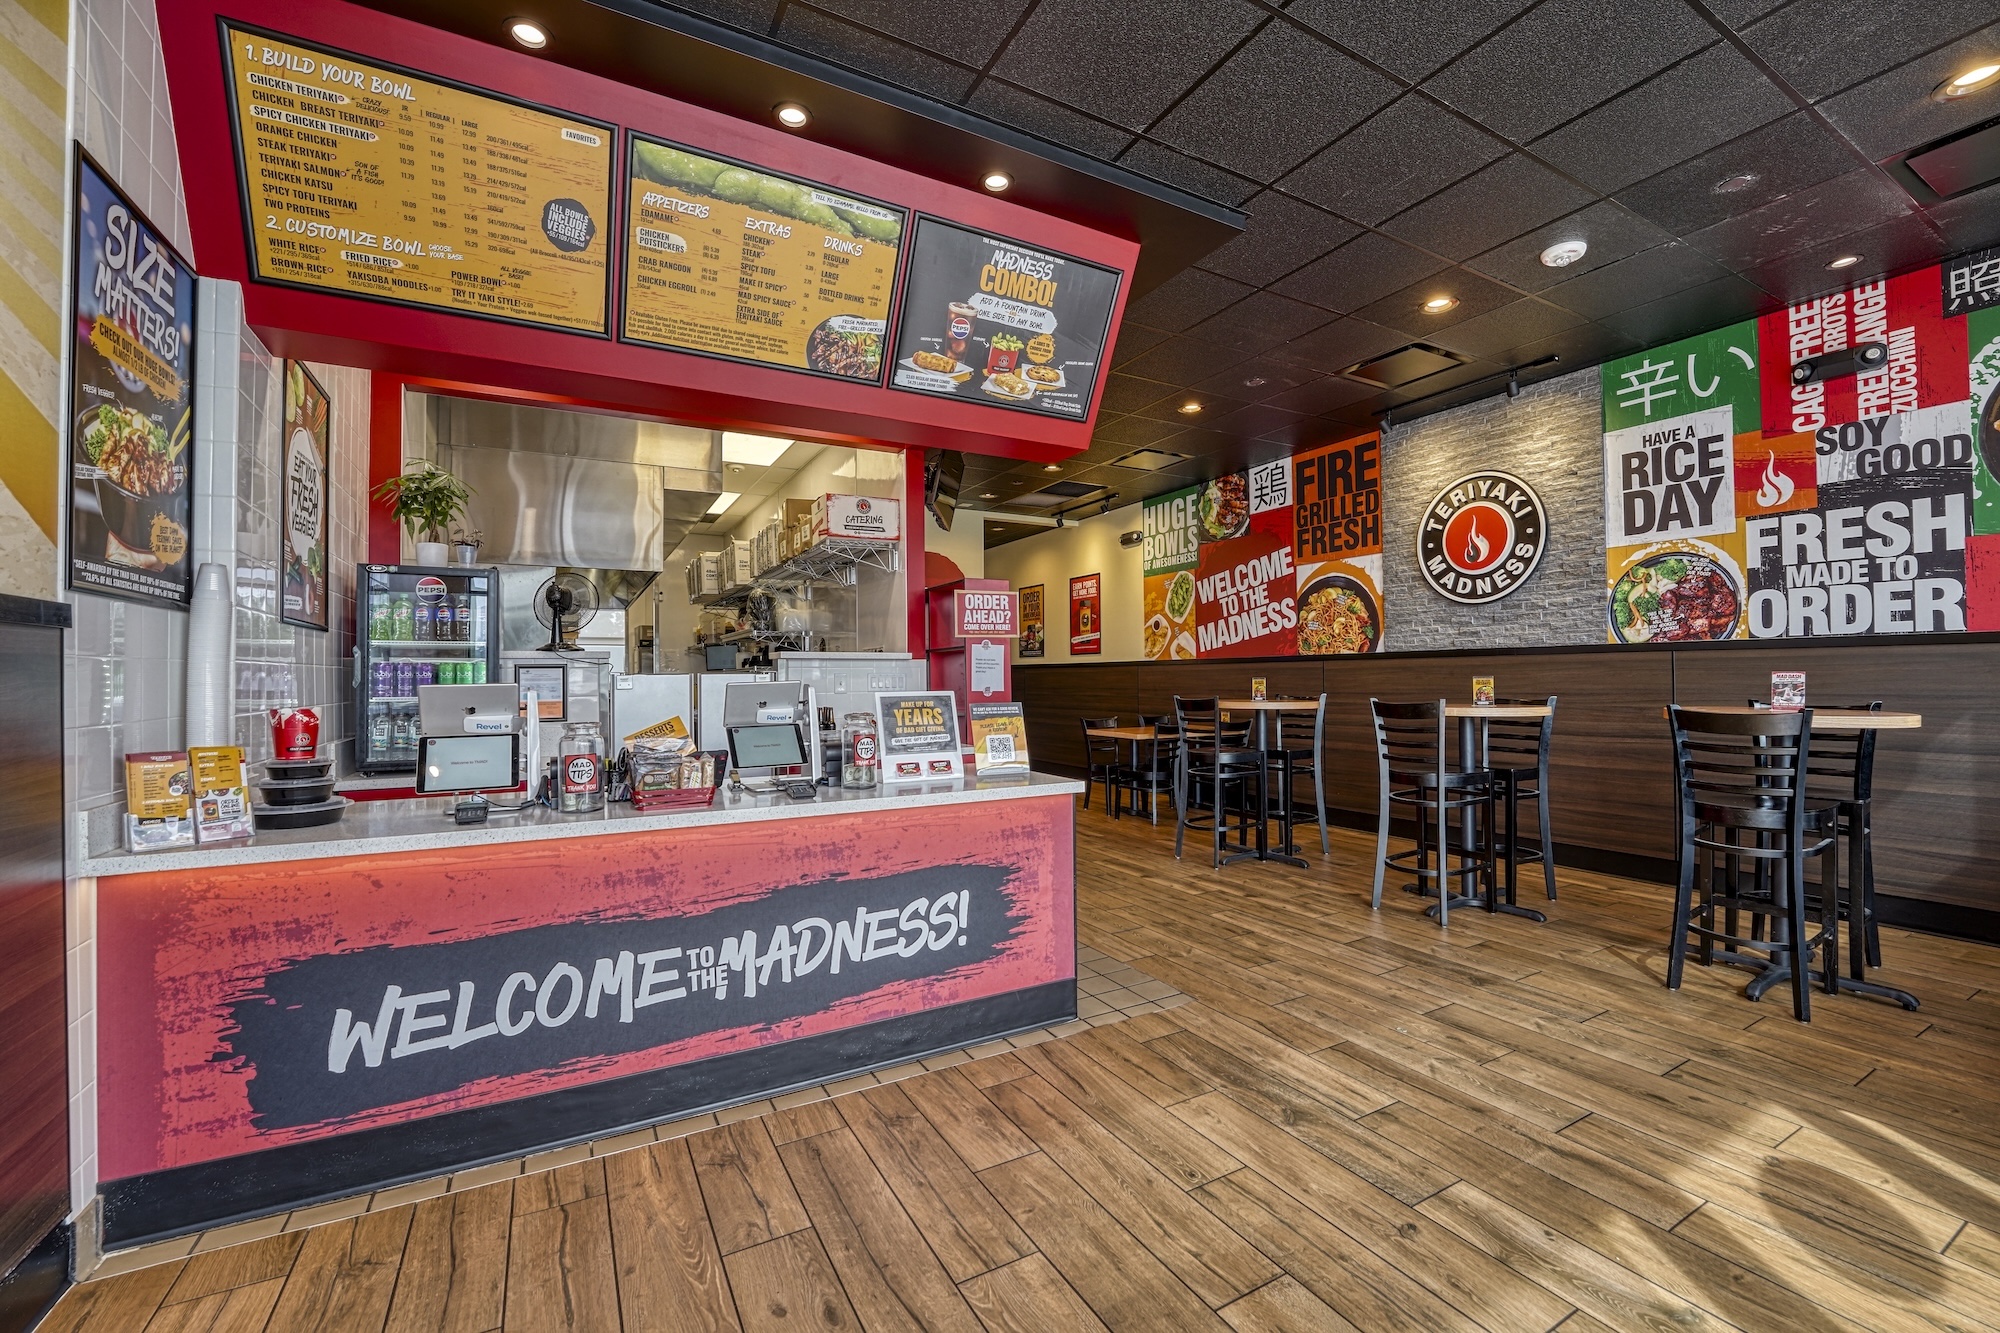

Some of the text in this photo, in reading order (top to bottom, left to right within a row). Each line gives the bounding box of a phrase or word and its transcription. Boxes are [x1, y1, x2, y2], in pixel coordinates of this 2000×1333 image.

[245, 44, 416, 101] 1. BUILD YOUR BOWL
[250, 73, 338, 103] CHICKEN TERIYAKI
[252, 90, 378, 128] CHICKEN BREAST TERIYAKI
[254, 105, 369, 140] SPICY CHICKEN TERIYAKI
[426, 111, 450, 123] REGULAR
[256, 122, 337, 148] ORANGE CHICKEN
[461, 120, 478, 129] LARGE
[565, 131, 596, 145] FAVORITES
[258, 138, 330, 161] STEAK TERIYAKI
[259, 153, 340, 178] TERIYAKI SALMON
[261, 168, 333, 191] CHICKEN KATSU
[263, 183, 357, 210] SPICY TOFU TERIYAKI
[642, 191, 710, 219] APPETIZERS
[549, 211, 587, 233] INCLUDE
[550, 203, 589, 223] ALL BOWLS
[641, 208, 674, 223] EDAMAME
[265, 215, 426, 256] 2. CUSTOMIZE BOWL
[547, 220, 585, 241] VEGGIES
[640, 228, 670, 241] CHICKEN
[743, 233, 770, 245] CHICKEN
[745, 217, 792, 239] EXTRAS
[269, 237, 320, 253] WHITE RICE
[639, 237, 685, 253] POTSTICKERS
[742, 248, 761, 259] STEAK
[823, 235, 863, 257] DRINKS
[105, 204, 176, 318] SIZE
[346, 251, 392, 267] FRIED RICE
[638, 256, 691, 273] CRAB RANGOON
[823, 253, 849, 265] REGULAR
[991, 250, 1054, 280] MADNESS
[347, 270, 428, 291] YAKISOBA NOODLES
[638, 275, 697, 293] CHICKEN EGGROLL
[821, 270, 839, 281] LARGE
[980, 264, 1058, 308] COMBO!
[94, 262, 180, 368] MATTERS!
[979, 309, 990, 317] ONE
[993, 312, 1005, 321] SIDE
[1029, 321, 1043, 329] BOWL
[980, 297, 993, 305] ADD
[1001, 302, 1028, 314] FOUNTAIN
[1030, 309, 1046, 319] DRINK
[1853, 280, 1887, 343] ANGE
[952, 323, 969, 333] PEPSI
[1821, 293, 1847, 353] RROTS
[100, 323, 120, 346] CHECK
[122, 338, 132, 355] OUT
[133, 346, 144, 363] OUR
[145, 355, 157, 373] HUGE
[1616, 346, 1755, 416] 辛い
[1889, 326, 1918, 414] ZUCCHINI
[1791, 380, 1826, 433] CAG
[1642, 425, 1696, 449] HAVE A
[1814, 416, 1889, 457] SOY
[1621, 433, 1725, 491] RICE
[1856, 432, 1973, 480] GOOD
[1295, 440, 1378, 505] FIRE
[291, 475, 319, 525] FRESH
[1253, 463, 1288, 512] 鶏
[1143, 493, 1197, 537] HUGE
[1296, 489, 1379, 529] GRILLED
[1426, 480, 1532, 532] TERIYAKI
[1623, 475, 1724, 537] DAY
[846, 516, 883, 524] CATERING
[1745, 493, 1966, 569] FRESH
[1144, 525, 1198, 560] BOWLS
[1297, 514, 1379, 558] FRESH
[1144, 551, 1198, 571] OF AWESOMENESS!
[1427, 542, 1534, 595] MADNESS
[1785, 554, 1919, 589] MADE TO
[1072, 582, 1082, 591] EARN
[1196, 546, 1295, 604] WELCOME
[965, 594, 1009, 610] ORDER
[1023, 591, 1040, 603] ORDER
[1219, 584, 1269, 618] TO THE
[1747, 577, 1966, 639] ORDER
[964, 610, 1011, 624] AHEAD?
[1197, 597, 1297, 652] MADNESS
[894, 708, 943, 726] YEARS
[859, 747, 873, 755] TIPS
[570, 768, 593, 779] TIPS
[686, 946, 714, 970] TO
[714, 888, 970, 1001] MADNESS!
[686, 963, 729, 992] THE
[327, 946, 688, 1075] WELCOME
